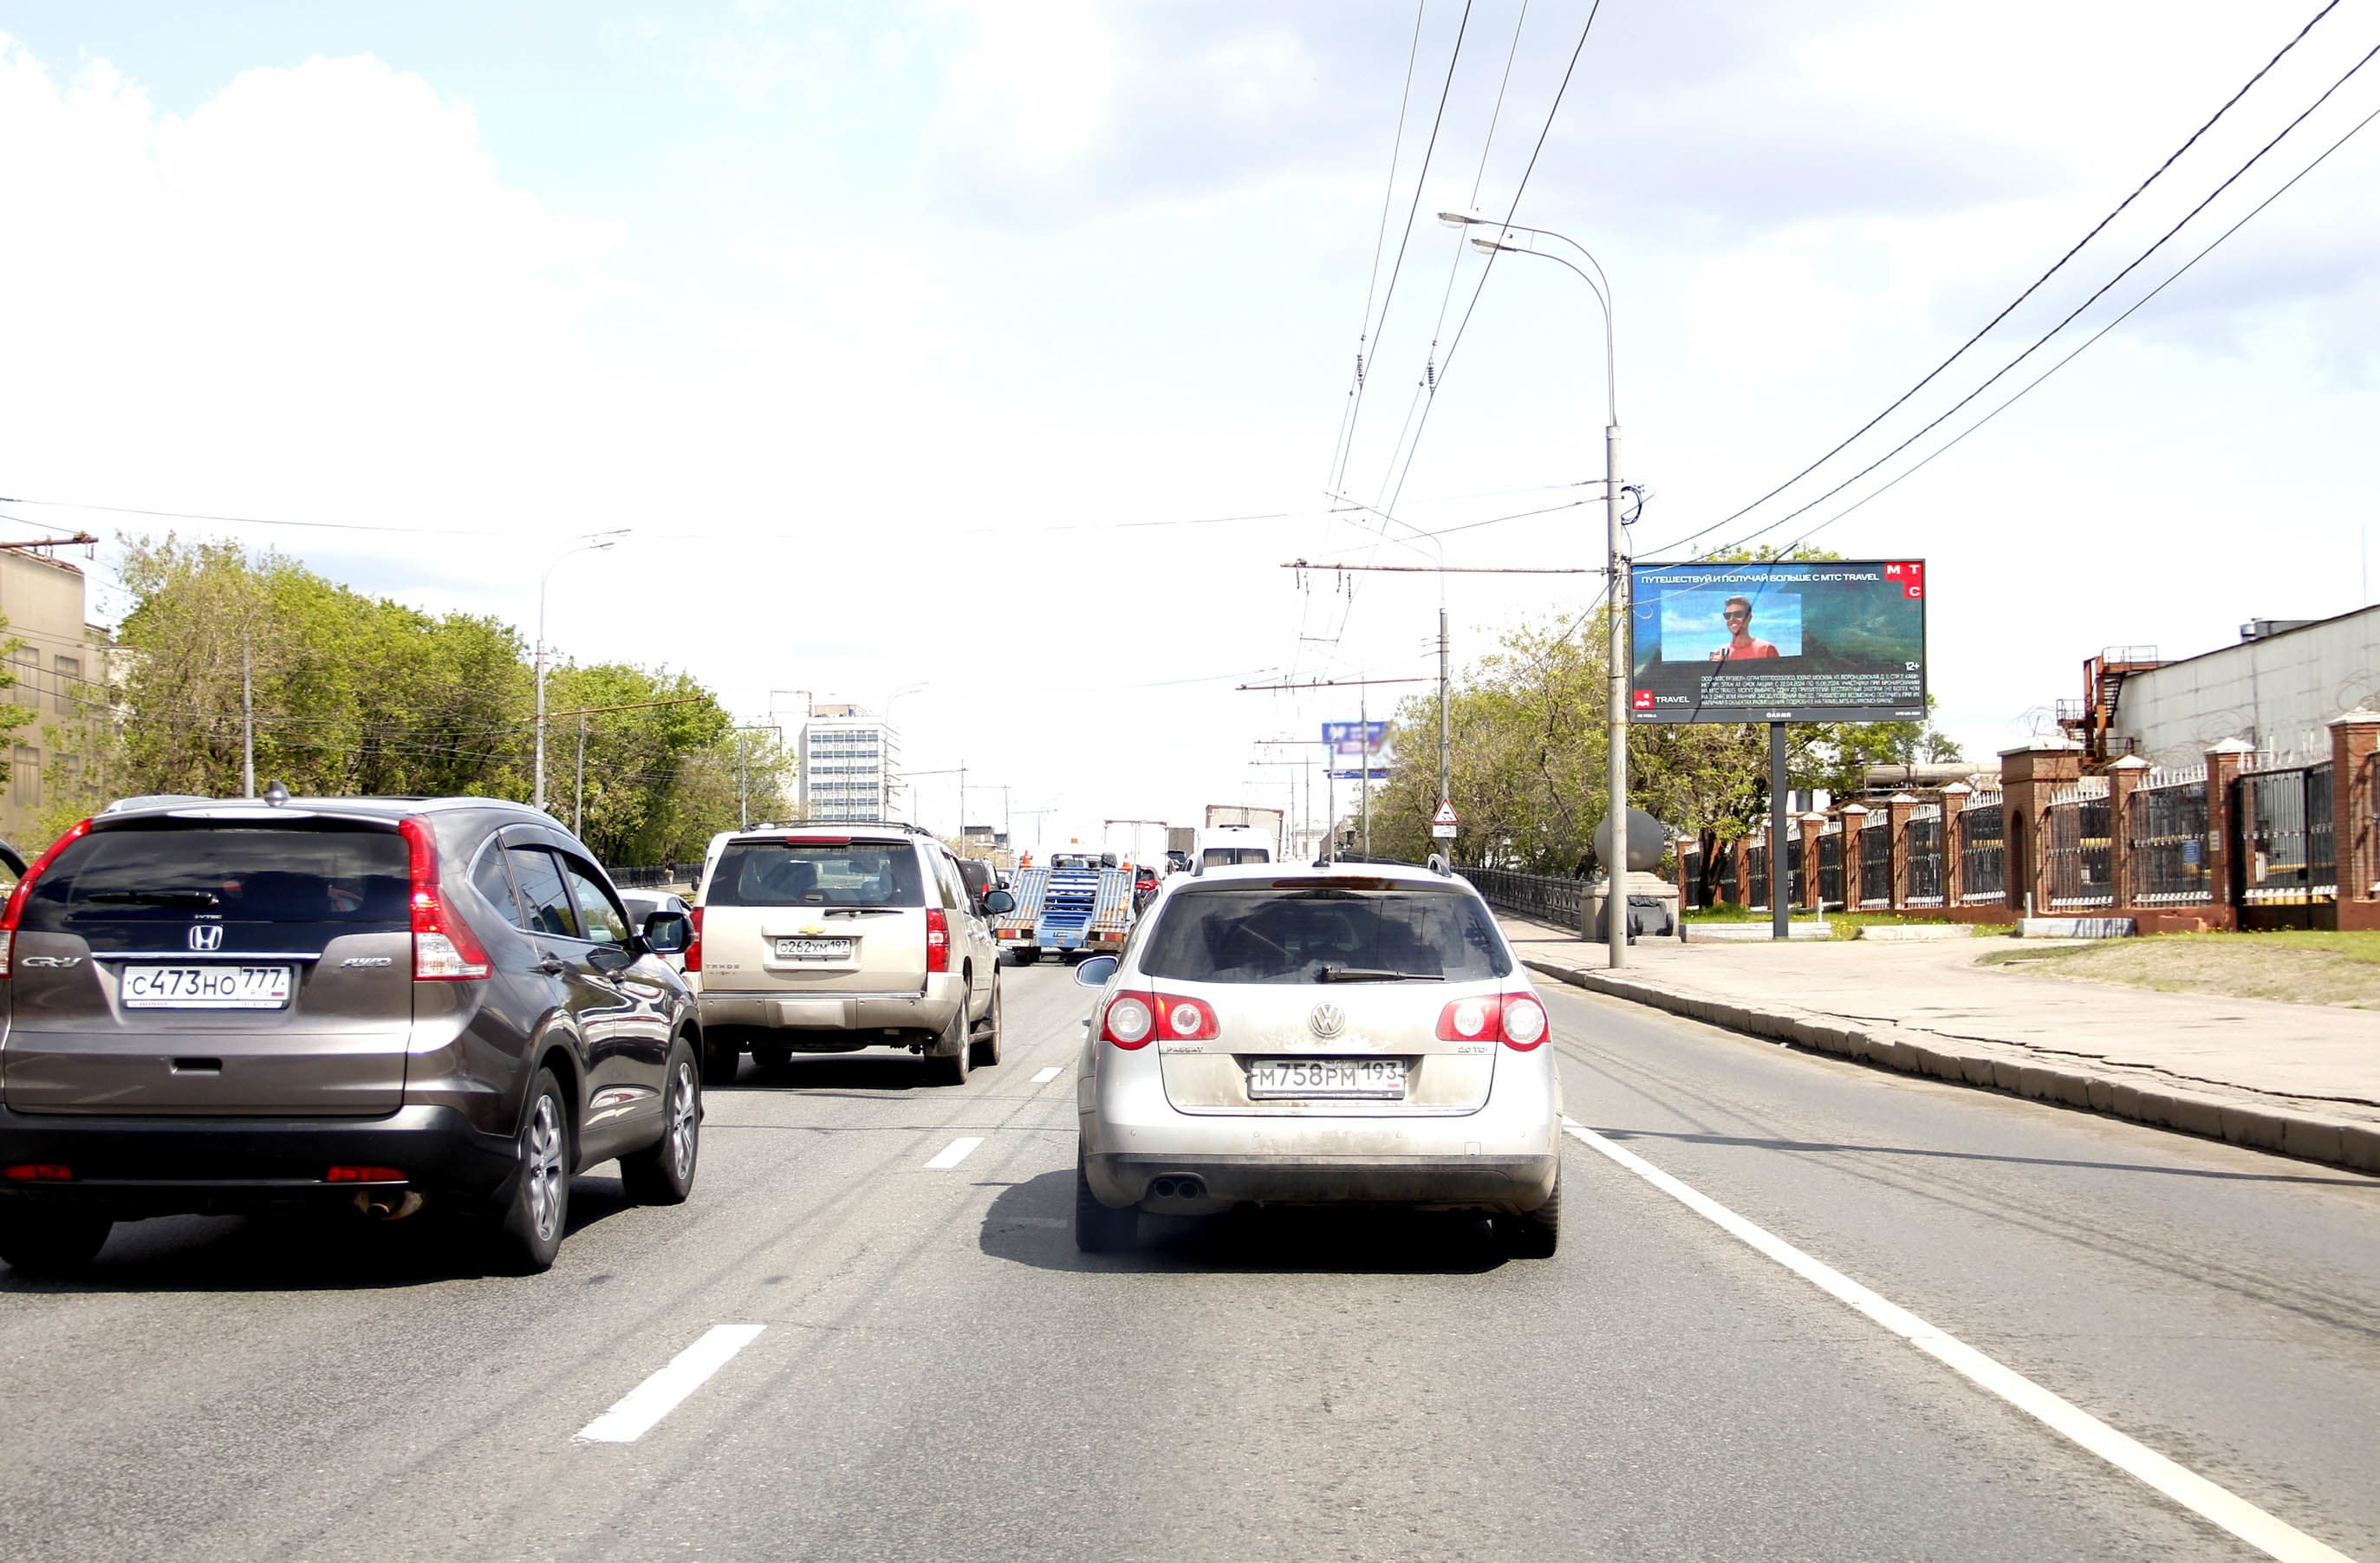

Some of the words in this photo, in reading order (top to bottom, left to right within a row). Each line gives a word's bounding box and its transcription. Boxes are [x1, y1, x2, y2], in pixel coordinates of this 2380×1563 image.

[1641, 574, 1711, 583] ПУТЕШЕСТВУЙ
[1722, 573, 1769, 583] ПОЛУЧАЙ
[1770, 574, 1811, 582] БОЛЬШЕ
[1905, 661, 1920, 671] 12+
[830, 941, 847, 951] 197
[22, 957, 83, 967] CR-V
[339, 957, 392, 968] AWD
[133, 970, 236, 995] С473НО
[243, 968, 282, 988] 777
[1260, 1062, 1356, 1086] М758РМ
[1360, 1062, 1397, 1080] 193
